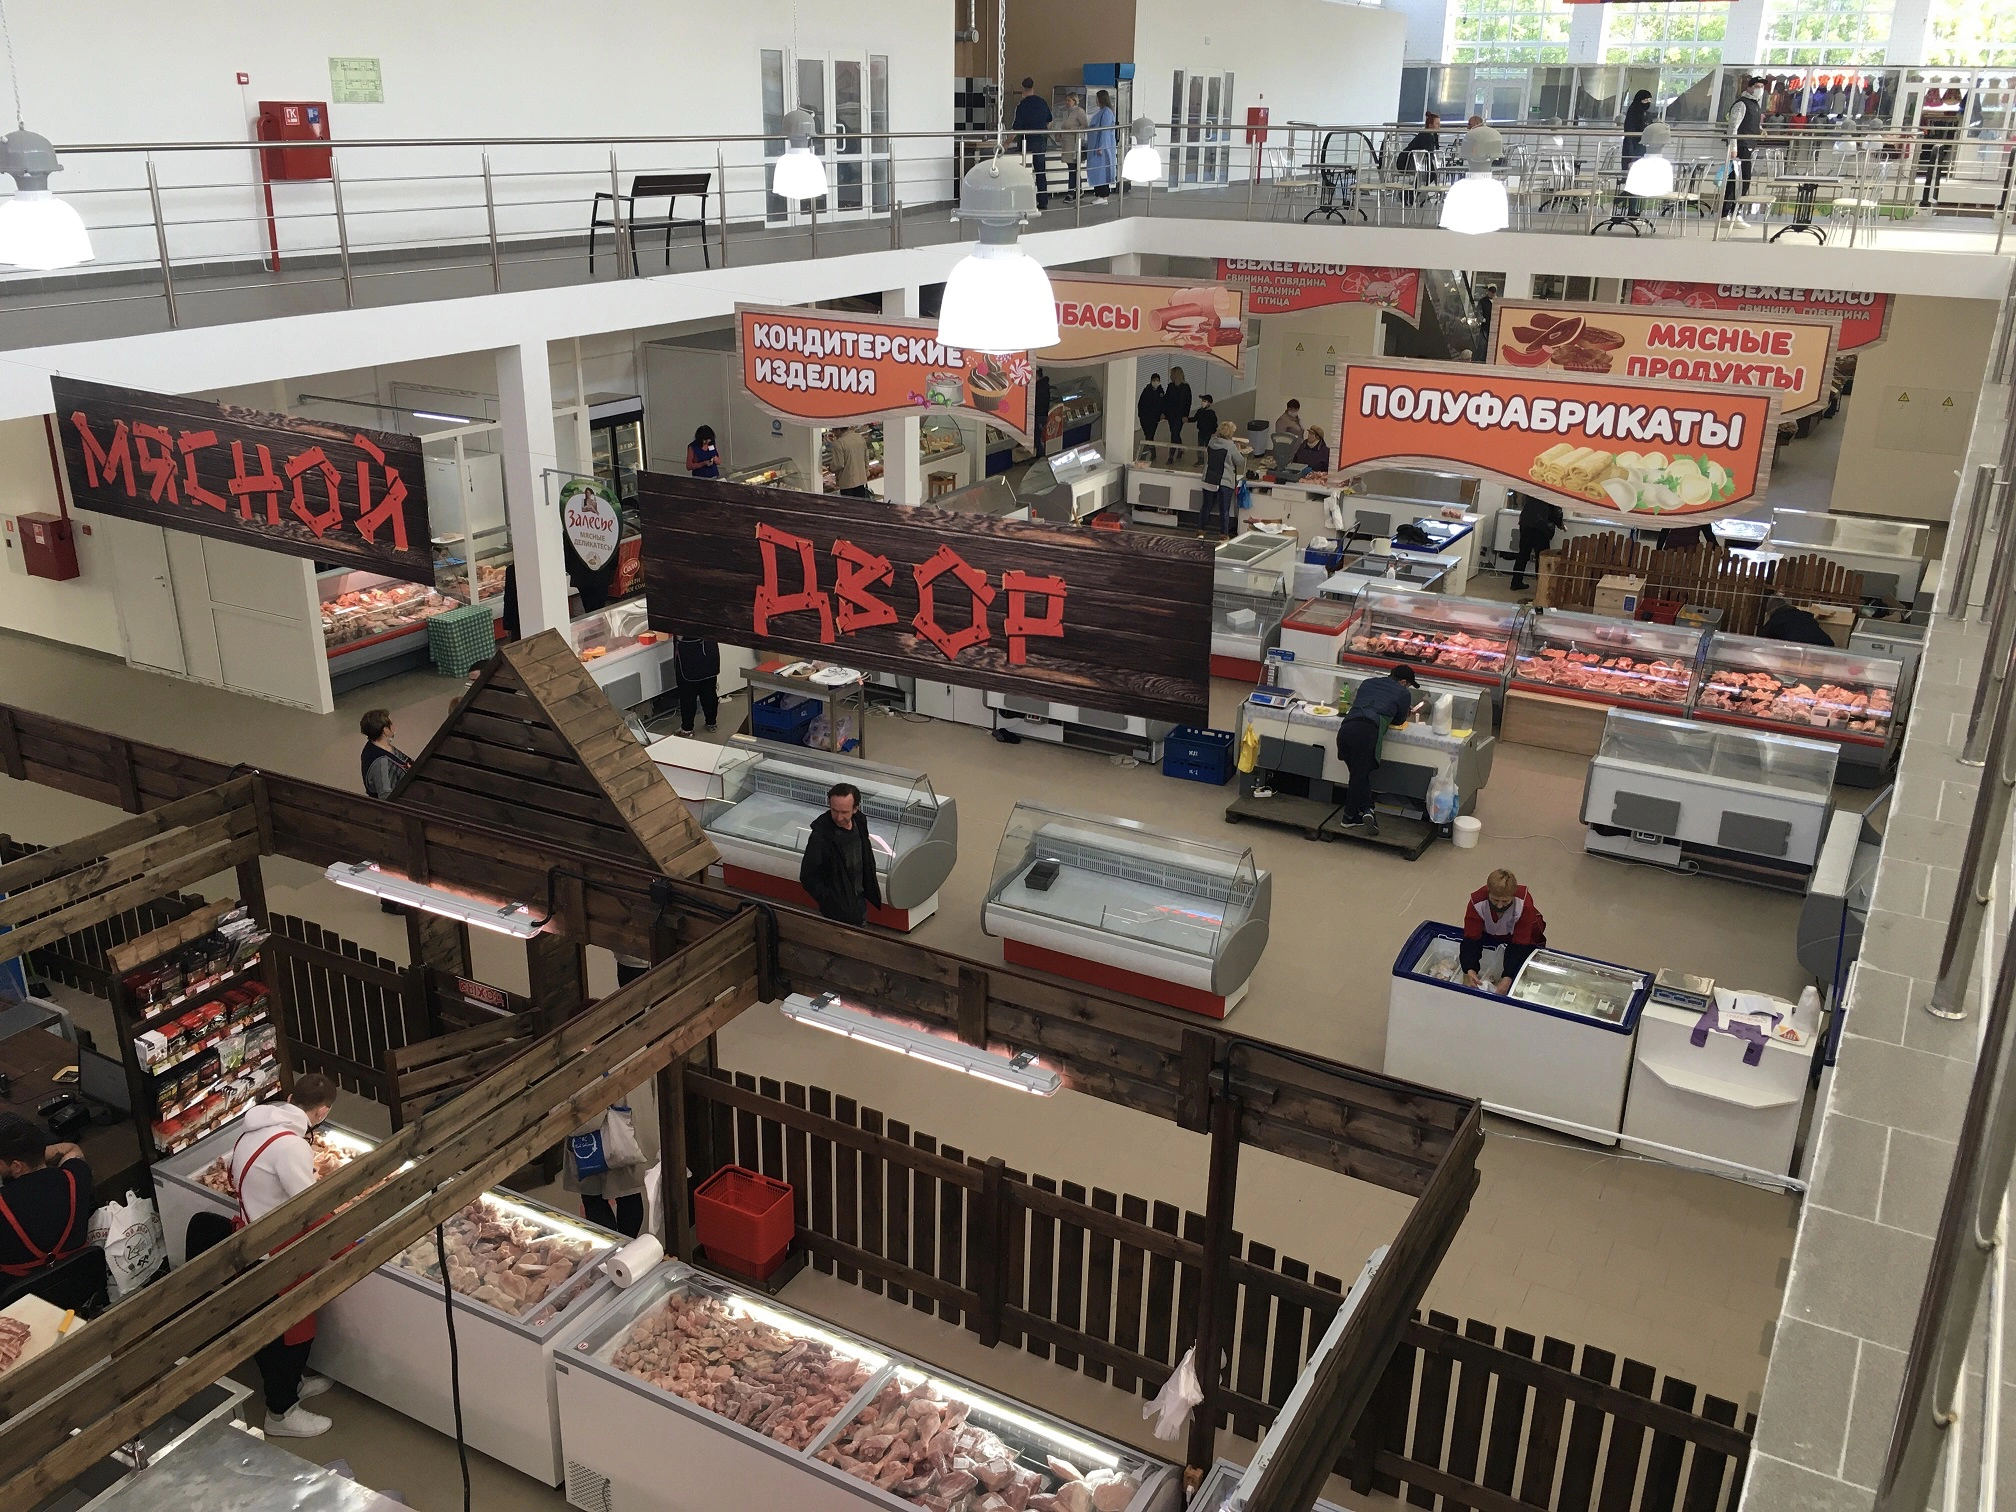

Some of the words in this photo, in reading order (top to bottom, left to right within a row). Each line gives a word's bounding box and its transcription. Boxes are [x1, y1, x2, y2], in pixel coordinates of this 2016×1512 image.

[1226, 258, 1294, 273] СВЕЖЕЕ
[1297, 263, 1347, 276] МЯСО
[1250, 285, 1301, 296] БАРАНИНА
[1274, 276, 1327, 288] ГОВЯДИНА
[1257, 296, 1290, 306] ПТИЦА
[1717, 284, 1805, 302] СВЕЖЕЕ
[1810, 289, 1875, 306] МЯСО
[1055, 303, 1139, 331] БАСЫ
[753, 323, 963, 368] КОНДИТЕРСКИЕ
[1647, 323, 1794, 356] МЯСНЫЕ
[755, 357, 875, 394] ИЗДЕЛИЯ
[1627, 355, 1804, 391] ПРОДУКТЫ
[1362, 385, 1743, 448] ПОЛУФАБРИКАТЫ
[71, 411, 408, 551] МЯСНОЙ
[568, 511, 613, 532] Залесье
[574, 538, 613, 551] ДЕЛИКАТЕСЫ
[580, 531, 605, 541] МЯСНЫЕ
[753, 521, 1068, 665] ДВОР
